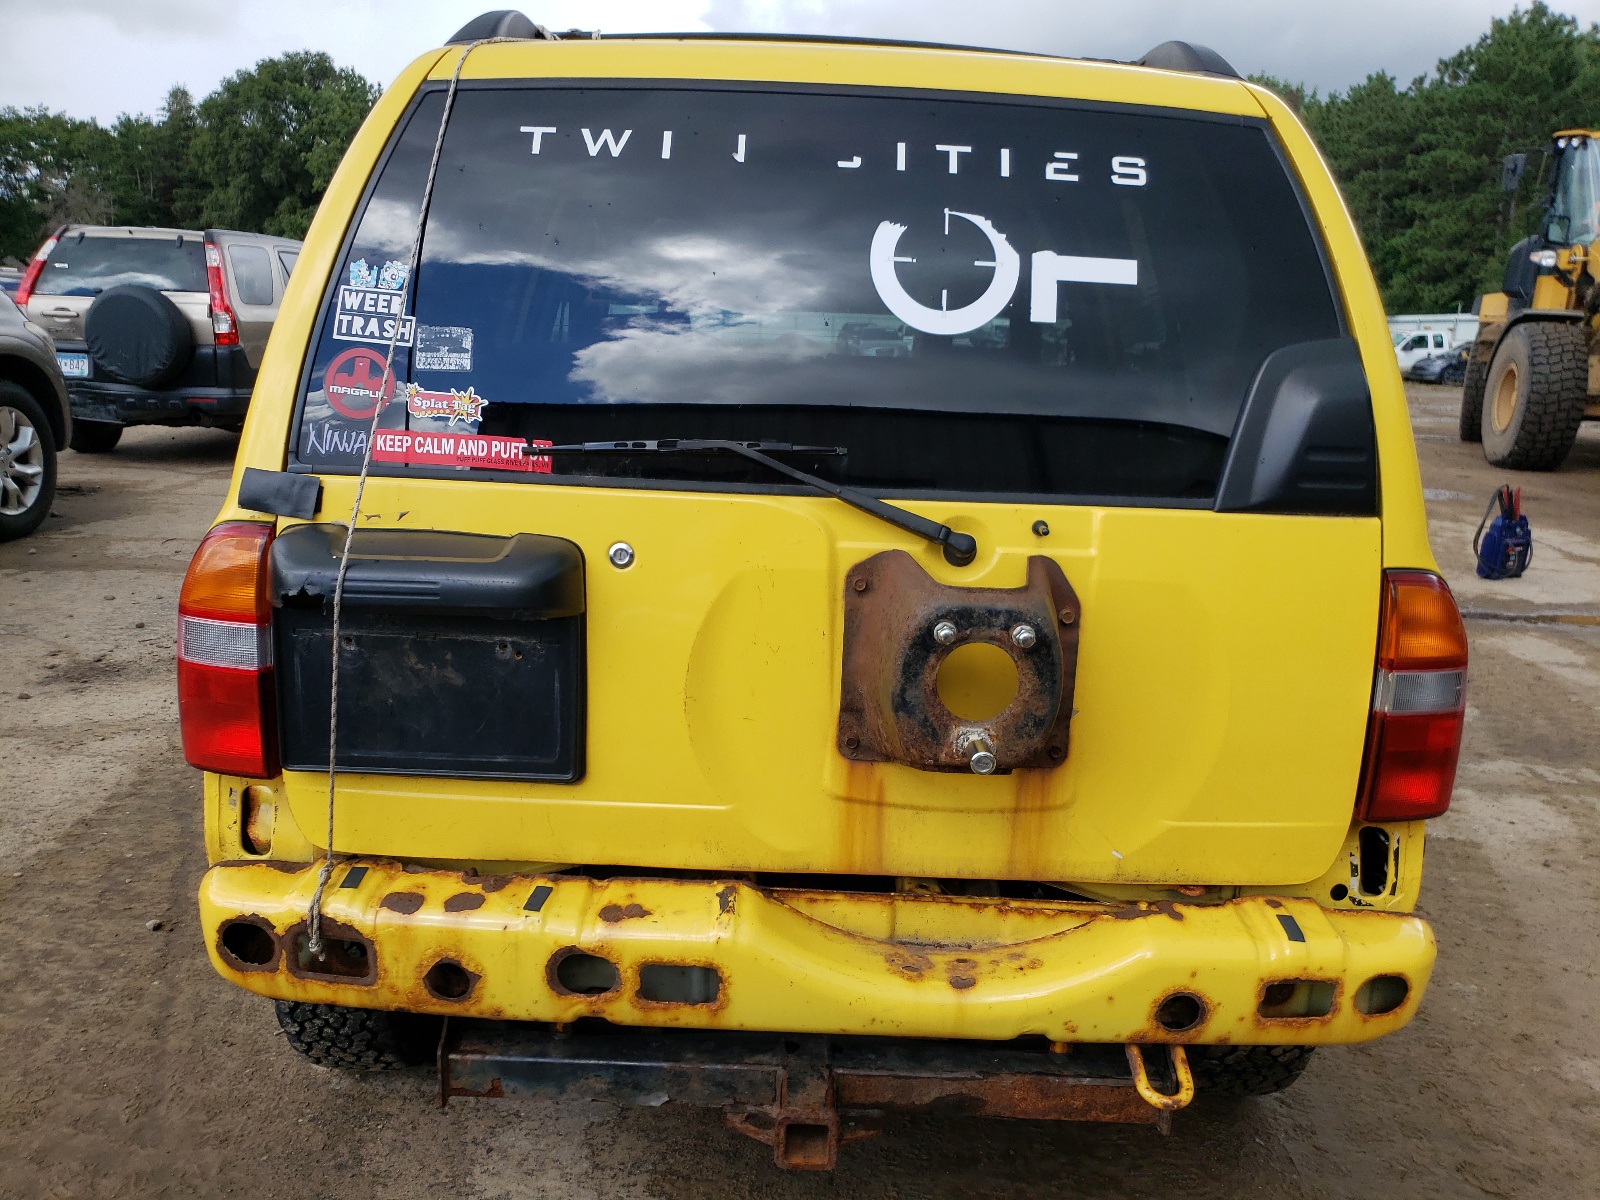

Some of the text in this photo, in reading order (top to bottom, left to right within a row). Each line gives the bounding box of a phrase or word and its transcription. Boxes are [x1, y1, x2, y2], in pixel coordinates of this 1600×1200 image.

[339, 314, 412, 341] TRASH
[413, 397, 476, 413] Splat Tag
[306, 423, 368, 455] NINJA
[376, 434, 411, 453] KEEP
[414, 436, 455, 455] CALM
[457, 438, 488, 457] AND
[491, 440, 528, 460] PUFF
[487, 458, 504, 466] GLASS
